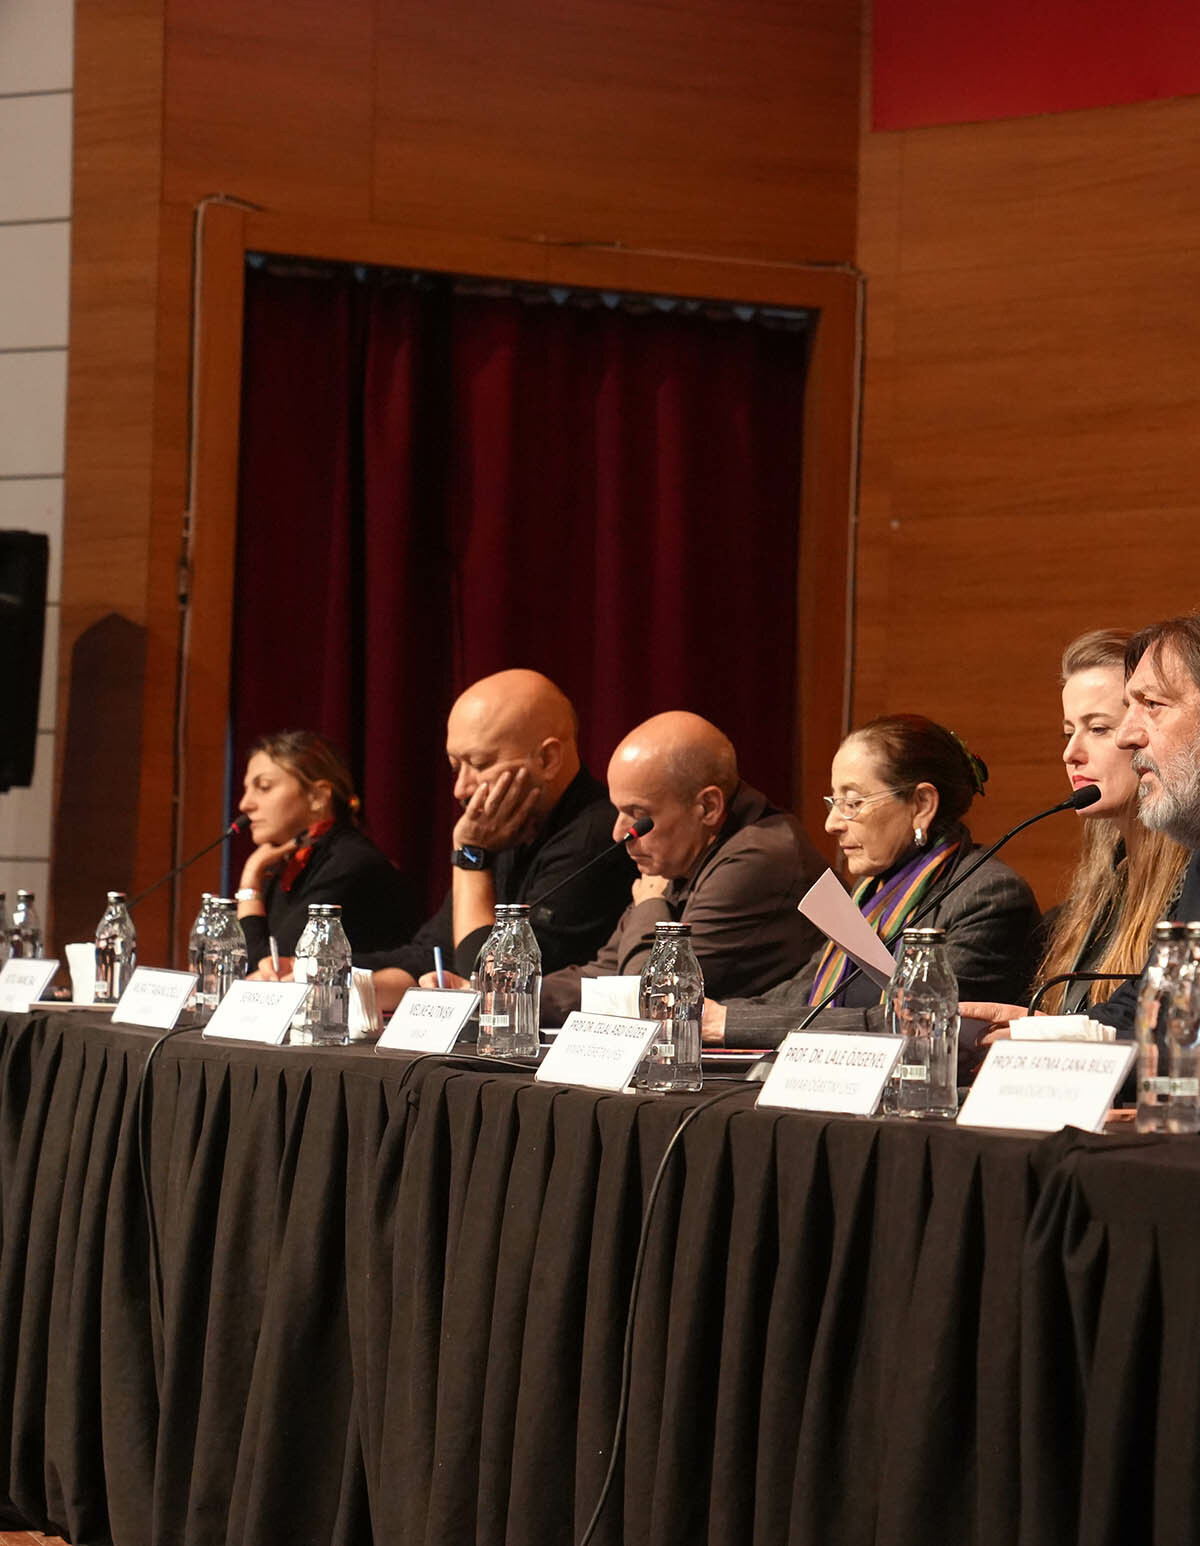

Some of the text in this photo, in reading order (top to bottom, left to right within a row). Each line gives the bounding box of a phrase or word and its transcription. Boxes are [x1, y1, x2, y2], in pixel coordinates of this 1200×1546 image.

[785, 1047, 889, 1068] PROF. DR. LALE ÖZGENEL
